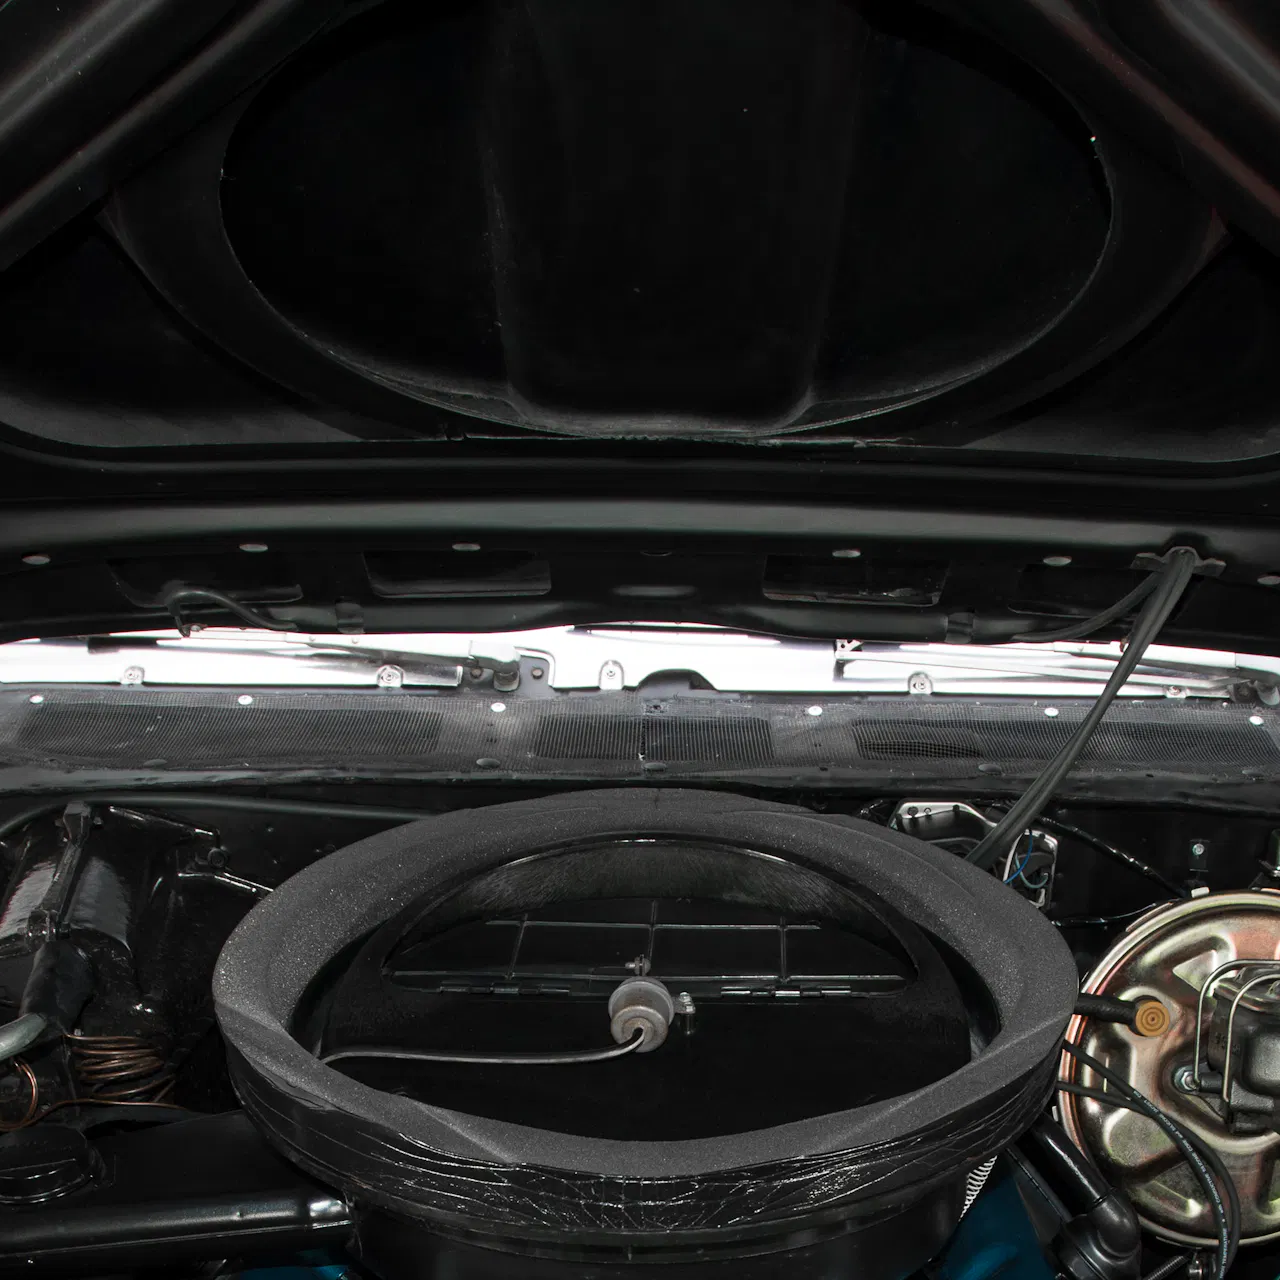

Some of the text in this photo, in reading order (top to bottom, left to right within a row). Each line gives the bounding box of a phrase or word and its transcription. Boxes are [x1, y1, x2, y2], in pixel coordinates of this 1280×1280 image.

[1158, 1114, 1176, 1131] SILICONE
[1182, 1139, 1194, 1152] CORE
[1192, 1152, 1206, 1173] SILICONE
[1204, 1173, 1220, 1203] CONDUCTIVE
